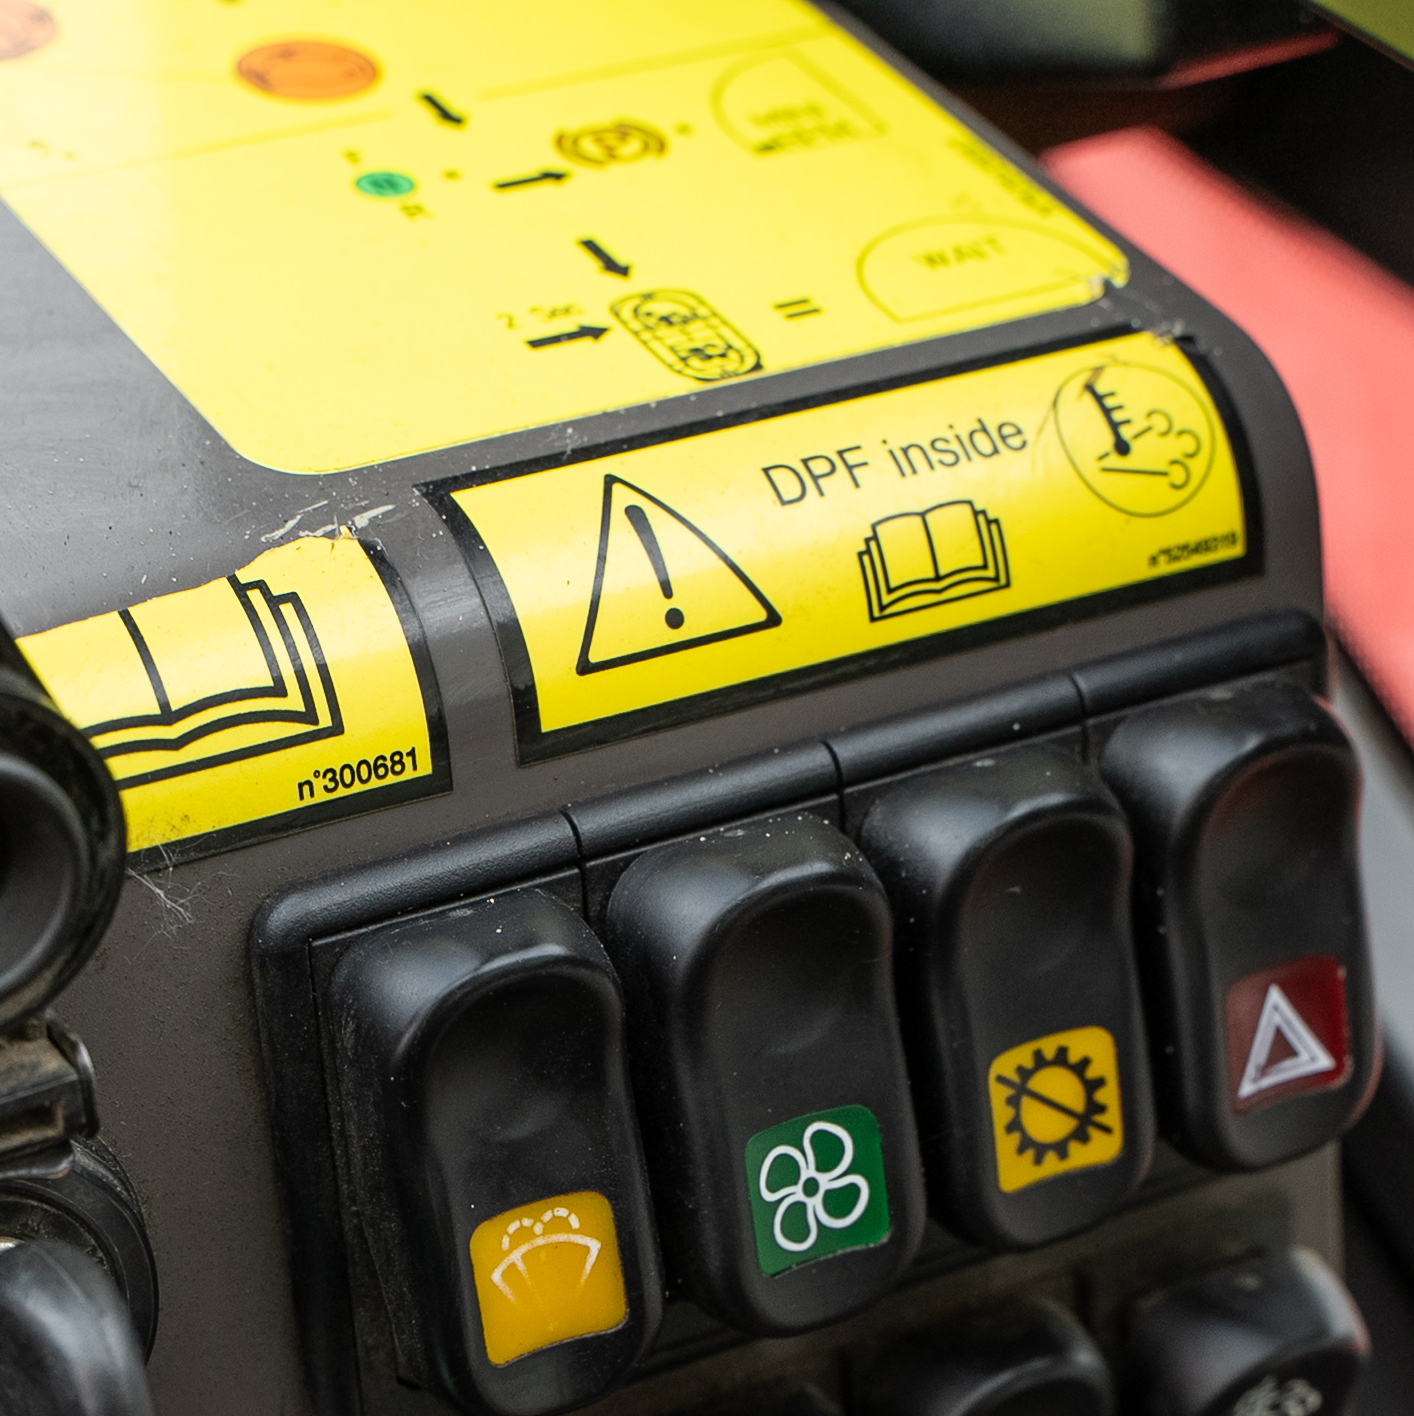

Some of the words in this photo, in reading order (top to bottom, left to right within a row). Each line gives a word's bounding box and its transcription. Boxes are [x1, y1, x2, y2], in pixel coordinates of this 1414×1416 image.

[760, 444, 870, 507] DPF
[881, 417, 1028, 479] inside
[296, 746, 419, 801] n°300681
